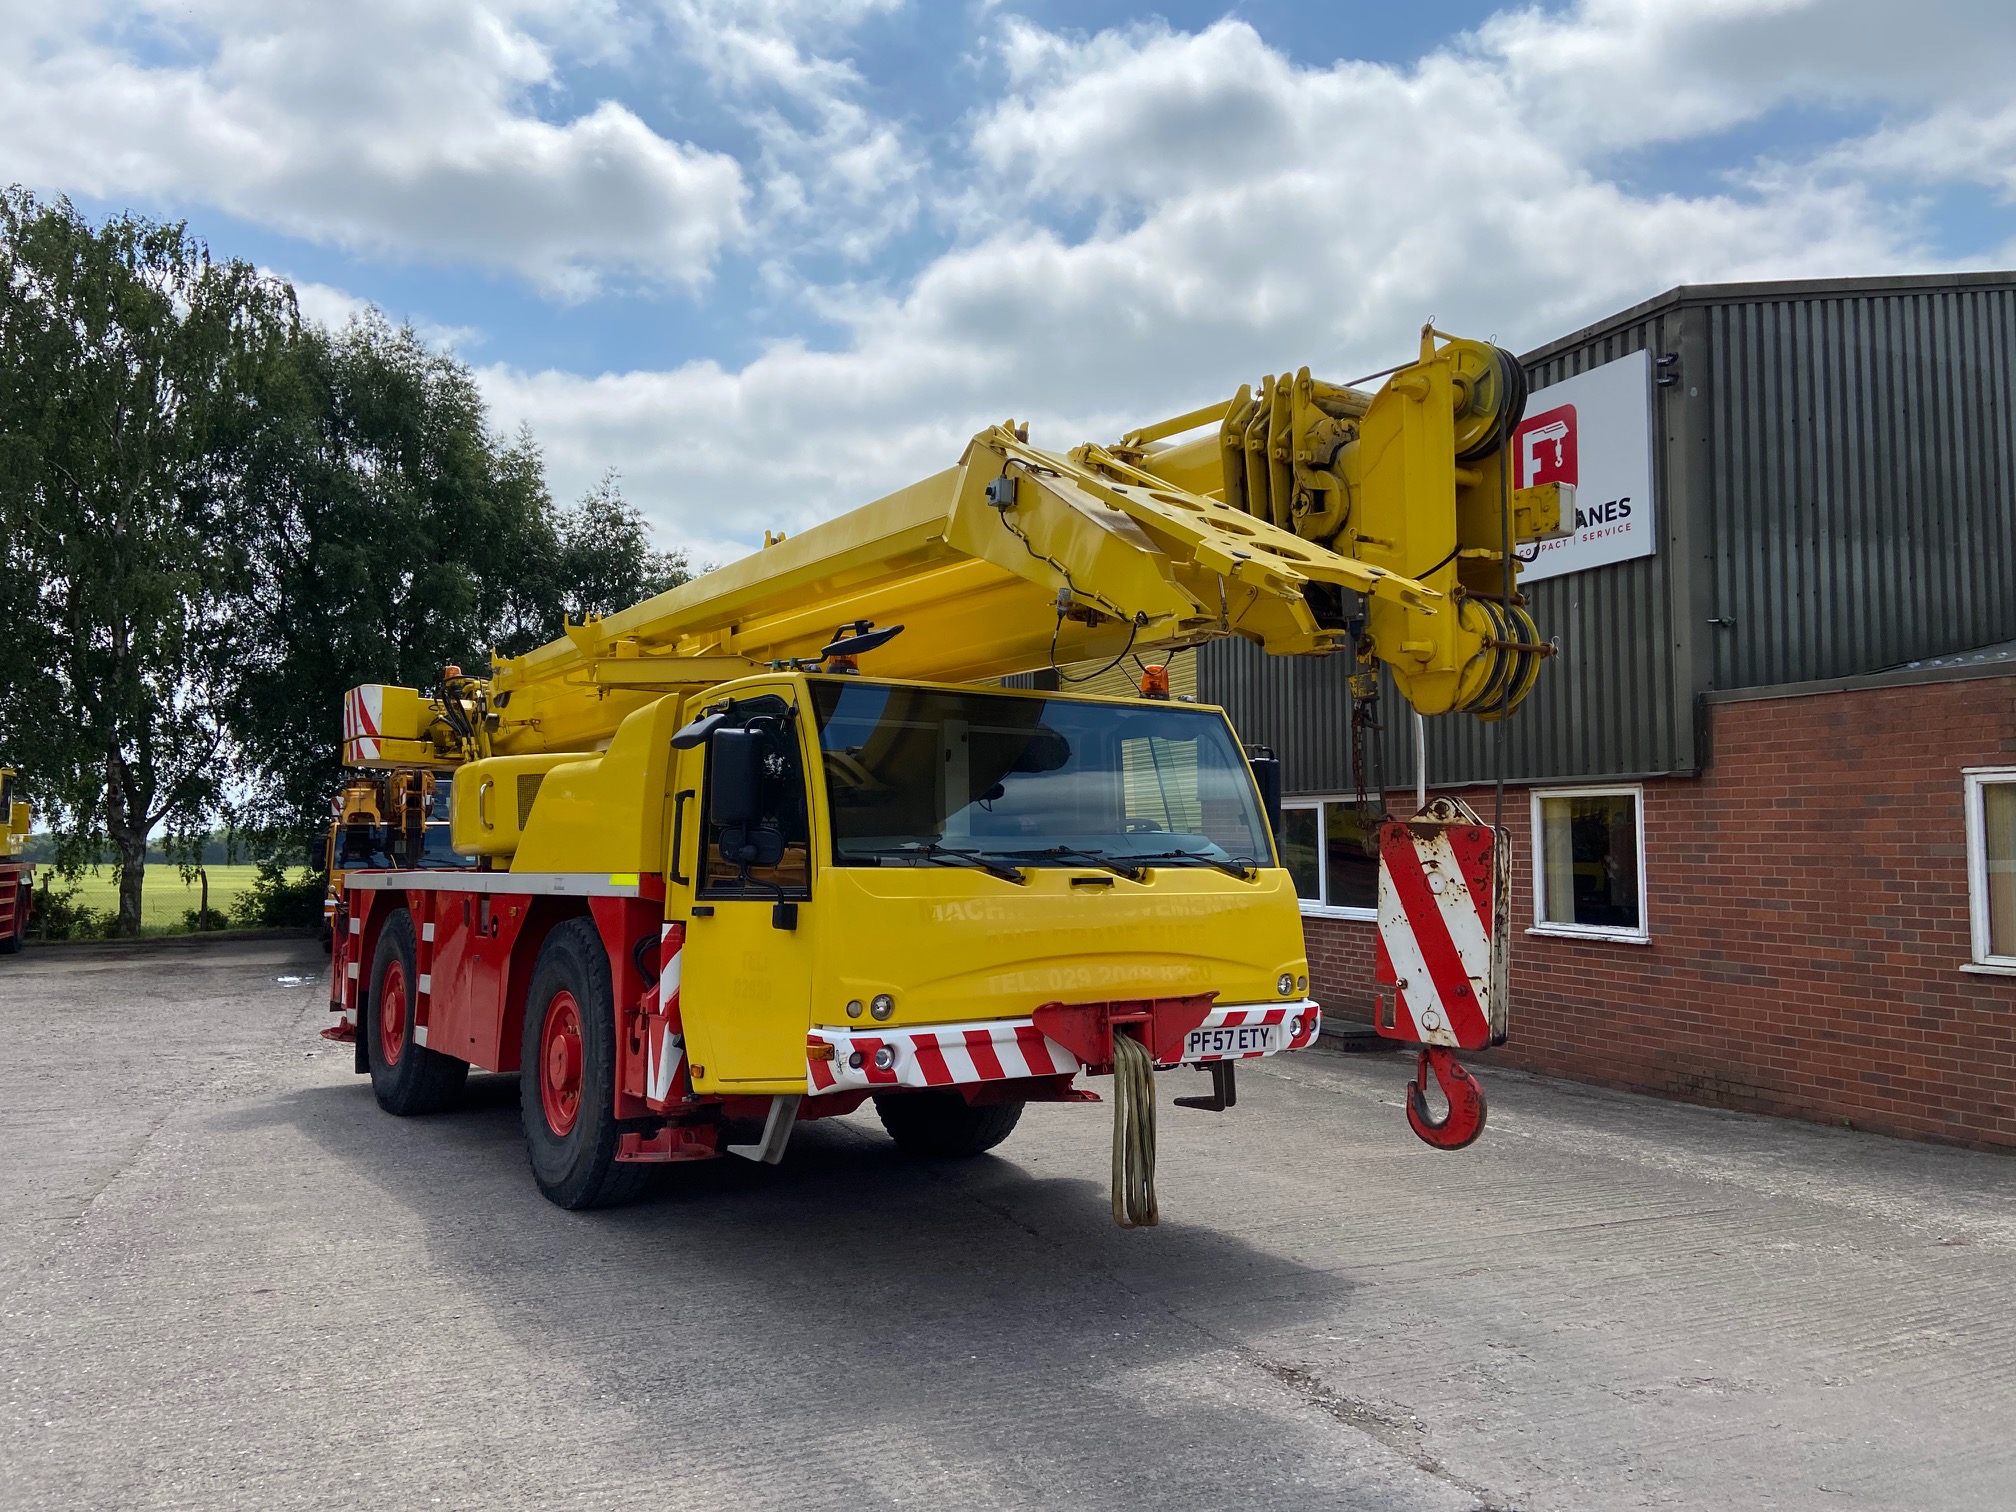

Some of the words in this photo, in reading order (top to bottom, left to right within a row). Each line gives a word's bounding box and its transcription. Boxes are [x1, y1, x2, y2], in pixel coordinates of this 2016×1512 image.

[1576, 497, 1632, 531] ANES
[1519, 540, 1568, 557] COPACT
[1583, 523, 1632, 542] SERVICE
[1048, 966, 1092, 991] 029
[1190, 1030, 1235, 1053] PF57
[1238, 1028, 1270, 1049] ETY
